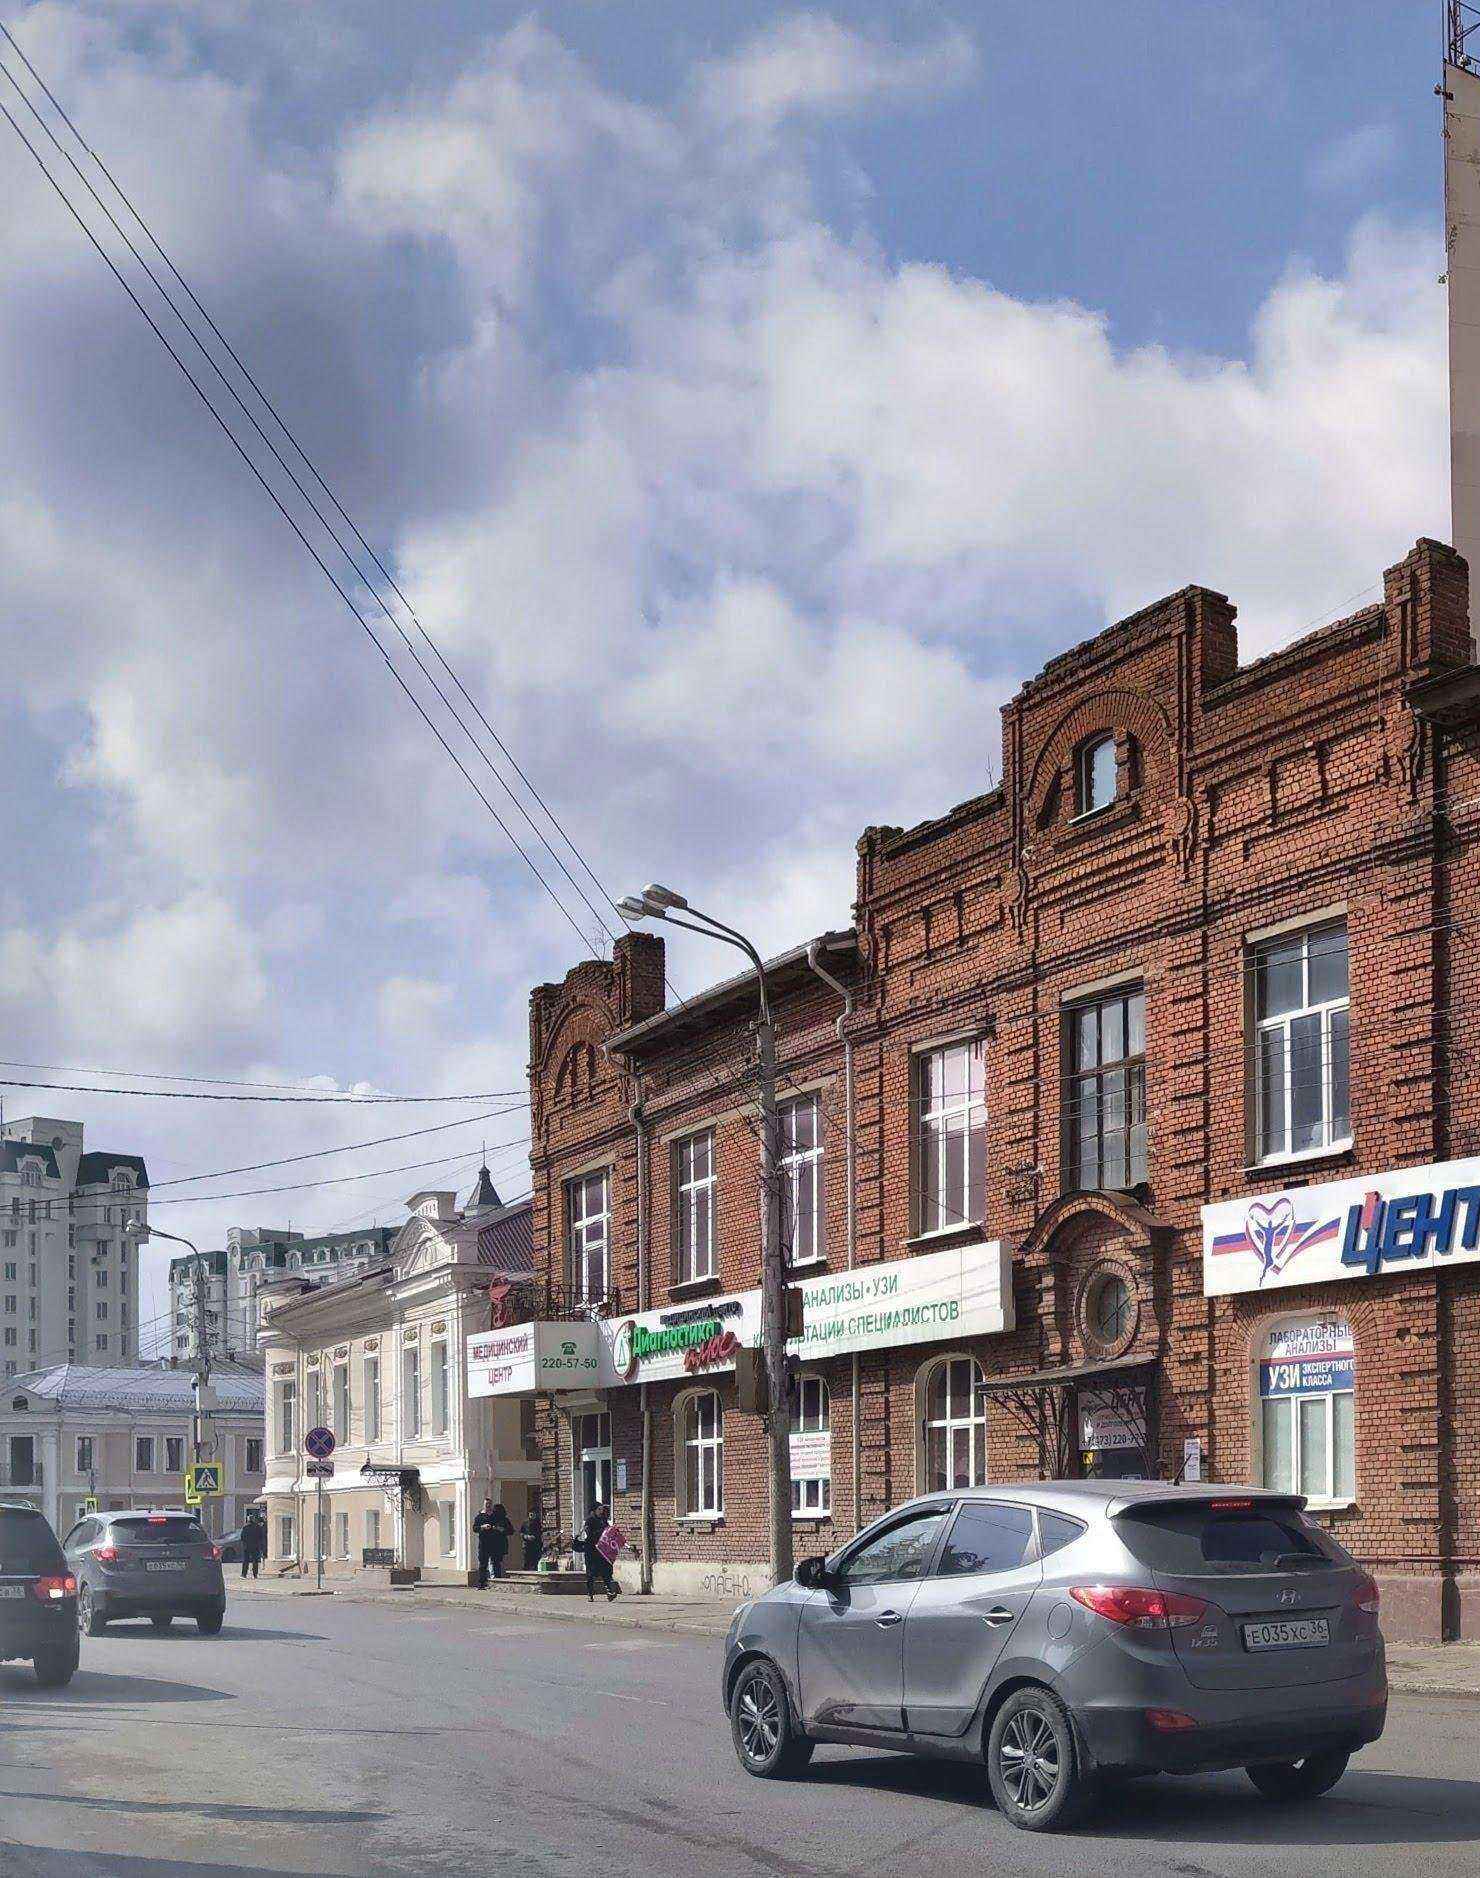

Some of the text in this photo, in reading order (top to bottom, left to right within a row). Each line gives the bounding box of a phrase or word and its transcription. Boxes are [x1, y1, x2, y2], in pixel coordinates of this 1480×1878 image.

[803, 1274, 898, 1308] АНАЛИЗЫ УЗИ
[472, 1333, 529, 1361] МЕДИЦИНСКИЙ
[1286, 1339, 1337, 1356] АНАЛИЗЫ
[541, 1357, 598, 1369] 220-57-50
[1302, 1360, 1355, 1374] ЭКСПЕРТНОГО
[488, 1366, 513, 1386] ЦЕНТР
[1268, 1363, 1300, 1390] УЗИ
[1303, 1374, 1333, 1387] КЛАССА
